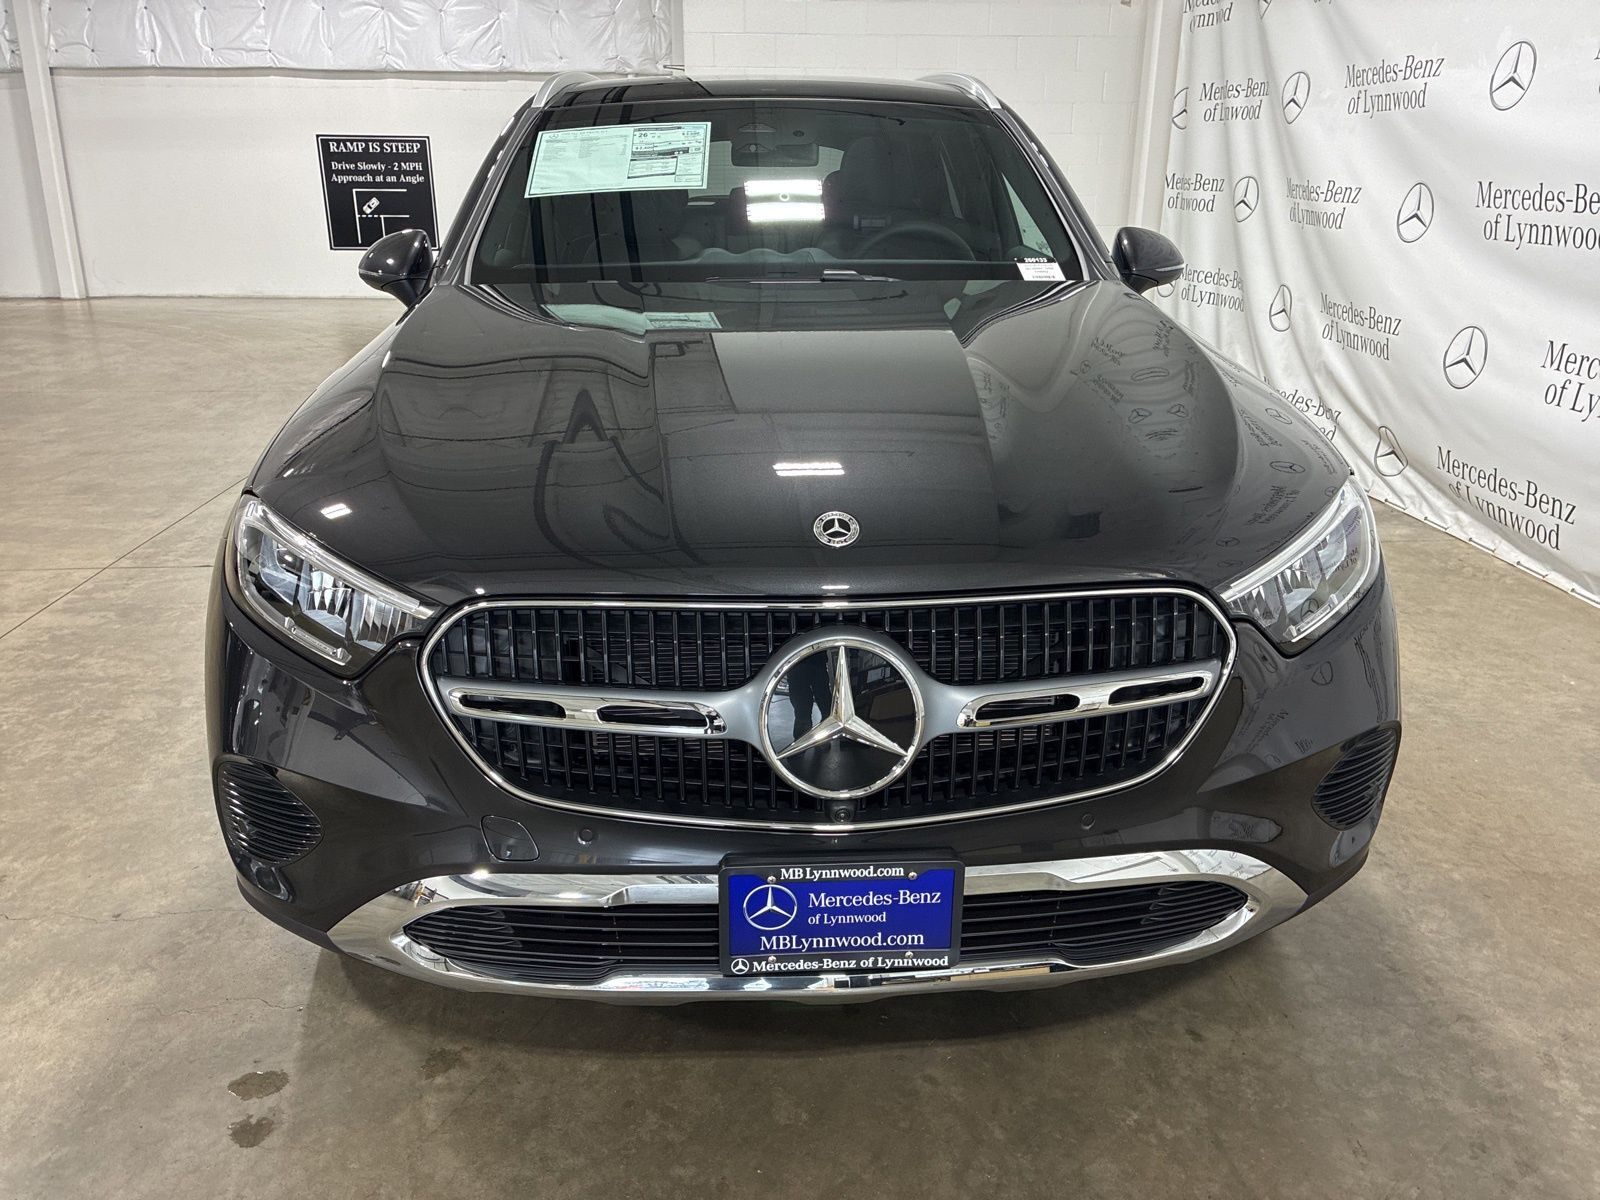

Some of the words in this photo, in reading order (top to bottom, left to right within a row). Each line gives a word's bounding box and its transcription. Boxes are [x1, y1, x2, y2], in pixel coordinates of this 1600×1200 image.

[1344, 55, 1444, 88] Mercedes-Benz
[1203, 102, 1219, 122] of
[1348, 90, 1363, 114] of
[1363, 82, 1427, 119] Lynnwood
[329, 141, 366, 153] RAMP
[368, 142, 380, 153] IS
[383, 142, 420, 153] STEEP
[331, 161, 355, 170] Drive
[357, 161, 386, 172] Slowly
[393, 162, 399, 171] 2
[401, 162, 423, 171] MPH
[331, 173, 370, 183] Approach
[374, 174, 383, 182] at
[399, 174, 425, 184] Angle
[1168, 192, 1180, 209] of
[1286, 177, 1362, 204] Mercedes-Benz
[1296, 203, 1346, 230] Lynnwood
[1483, 213, 1502, 241] of
[1504, 214, 1600, 250] Lynnwoo
[1181, 284, 1191, 301] of
[1320, 292, 1402, 336] Mercedes-Benz
[1322, 321, 1334, 340] of
[1335, 322, 1390, 361] Lynnwood
[1544, 379, 1571, 408] of
[1437, 445, 1577, 525] Mercedes-Benz
[1448, 481, 1463, 501] of
[1464, 485, 1561, 551] Lynnwood
[808, 889, 941, 908] Mercedes-Benz
[808, 913, 822, 925] of
[823, 911, 887, 927] Lynnwood
[760, 932, 925, 952] MBLynnwood.com
[752, 958, 857, 973] Mercedes-Benz
[860, 957, 874, 968] of
[876, 956, 949, 969] Lynnwood
